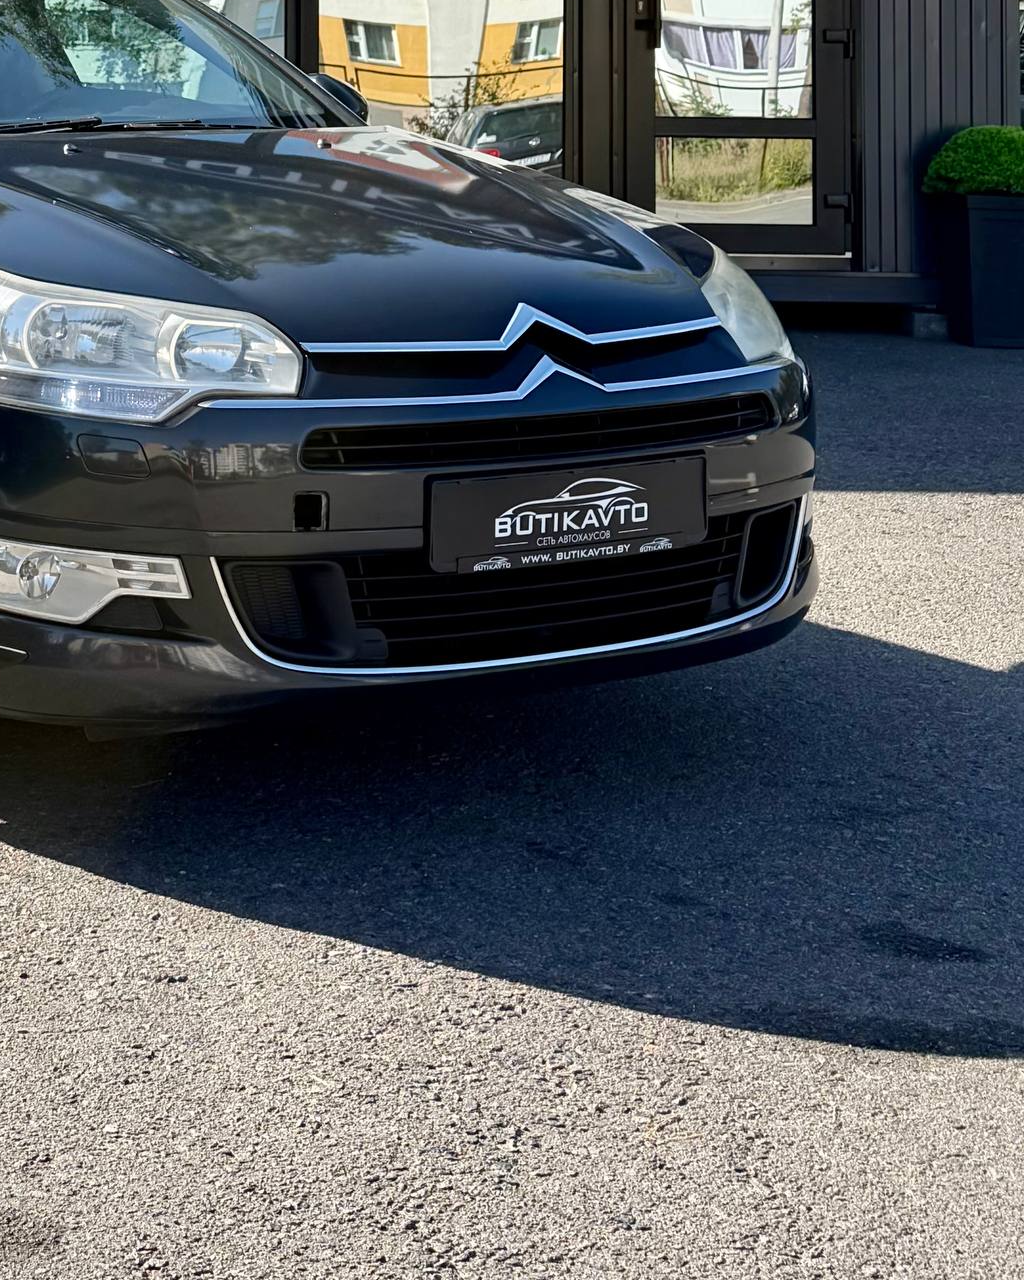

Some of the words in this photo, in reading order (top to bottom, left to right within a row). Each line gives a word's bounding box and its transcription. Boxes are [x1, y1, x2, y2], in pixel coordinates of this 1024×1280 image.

[494, 502, 648, 538] BUTIKAVTO
[557, 530, 611, 545] АВТОХАУСОВ
[639, 543, 673, 553] BUTIKAVTO
[473, 562, 511, 572] BUTIKAVTO
